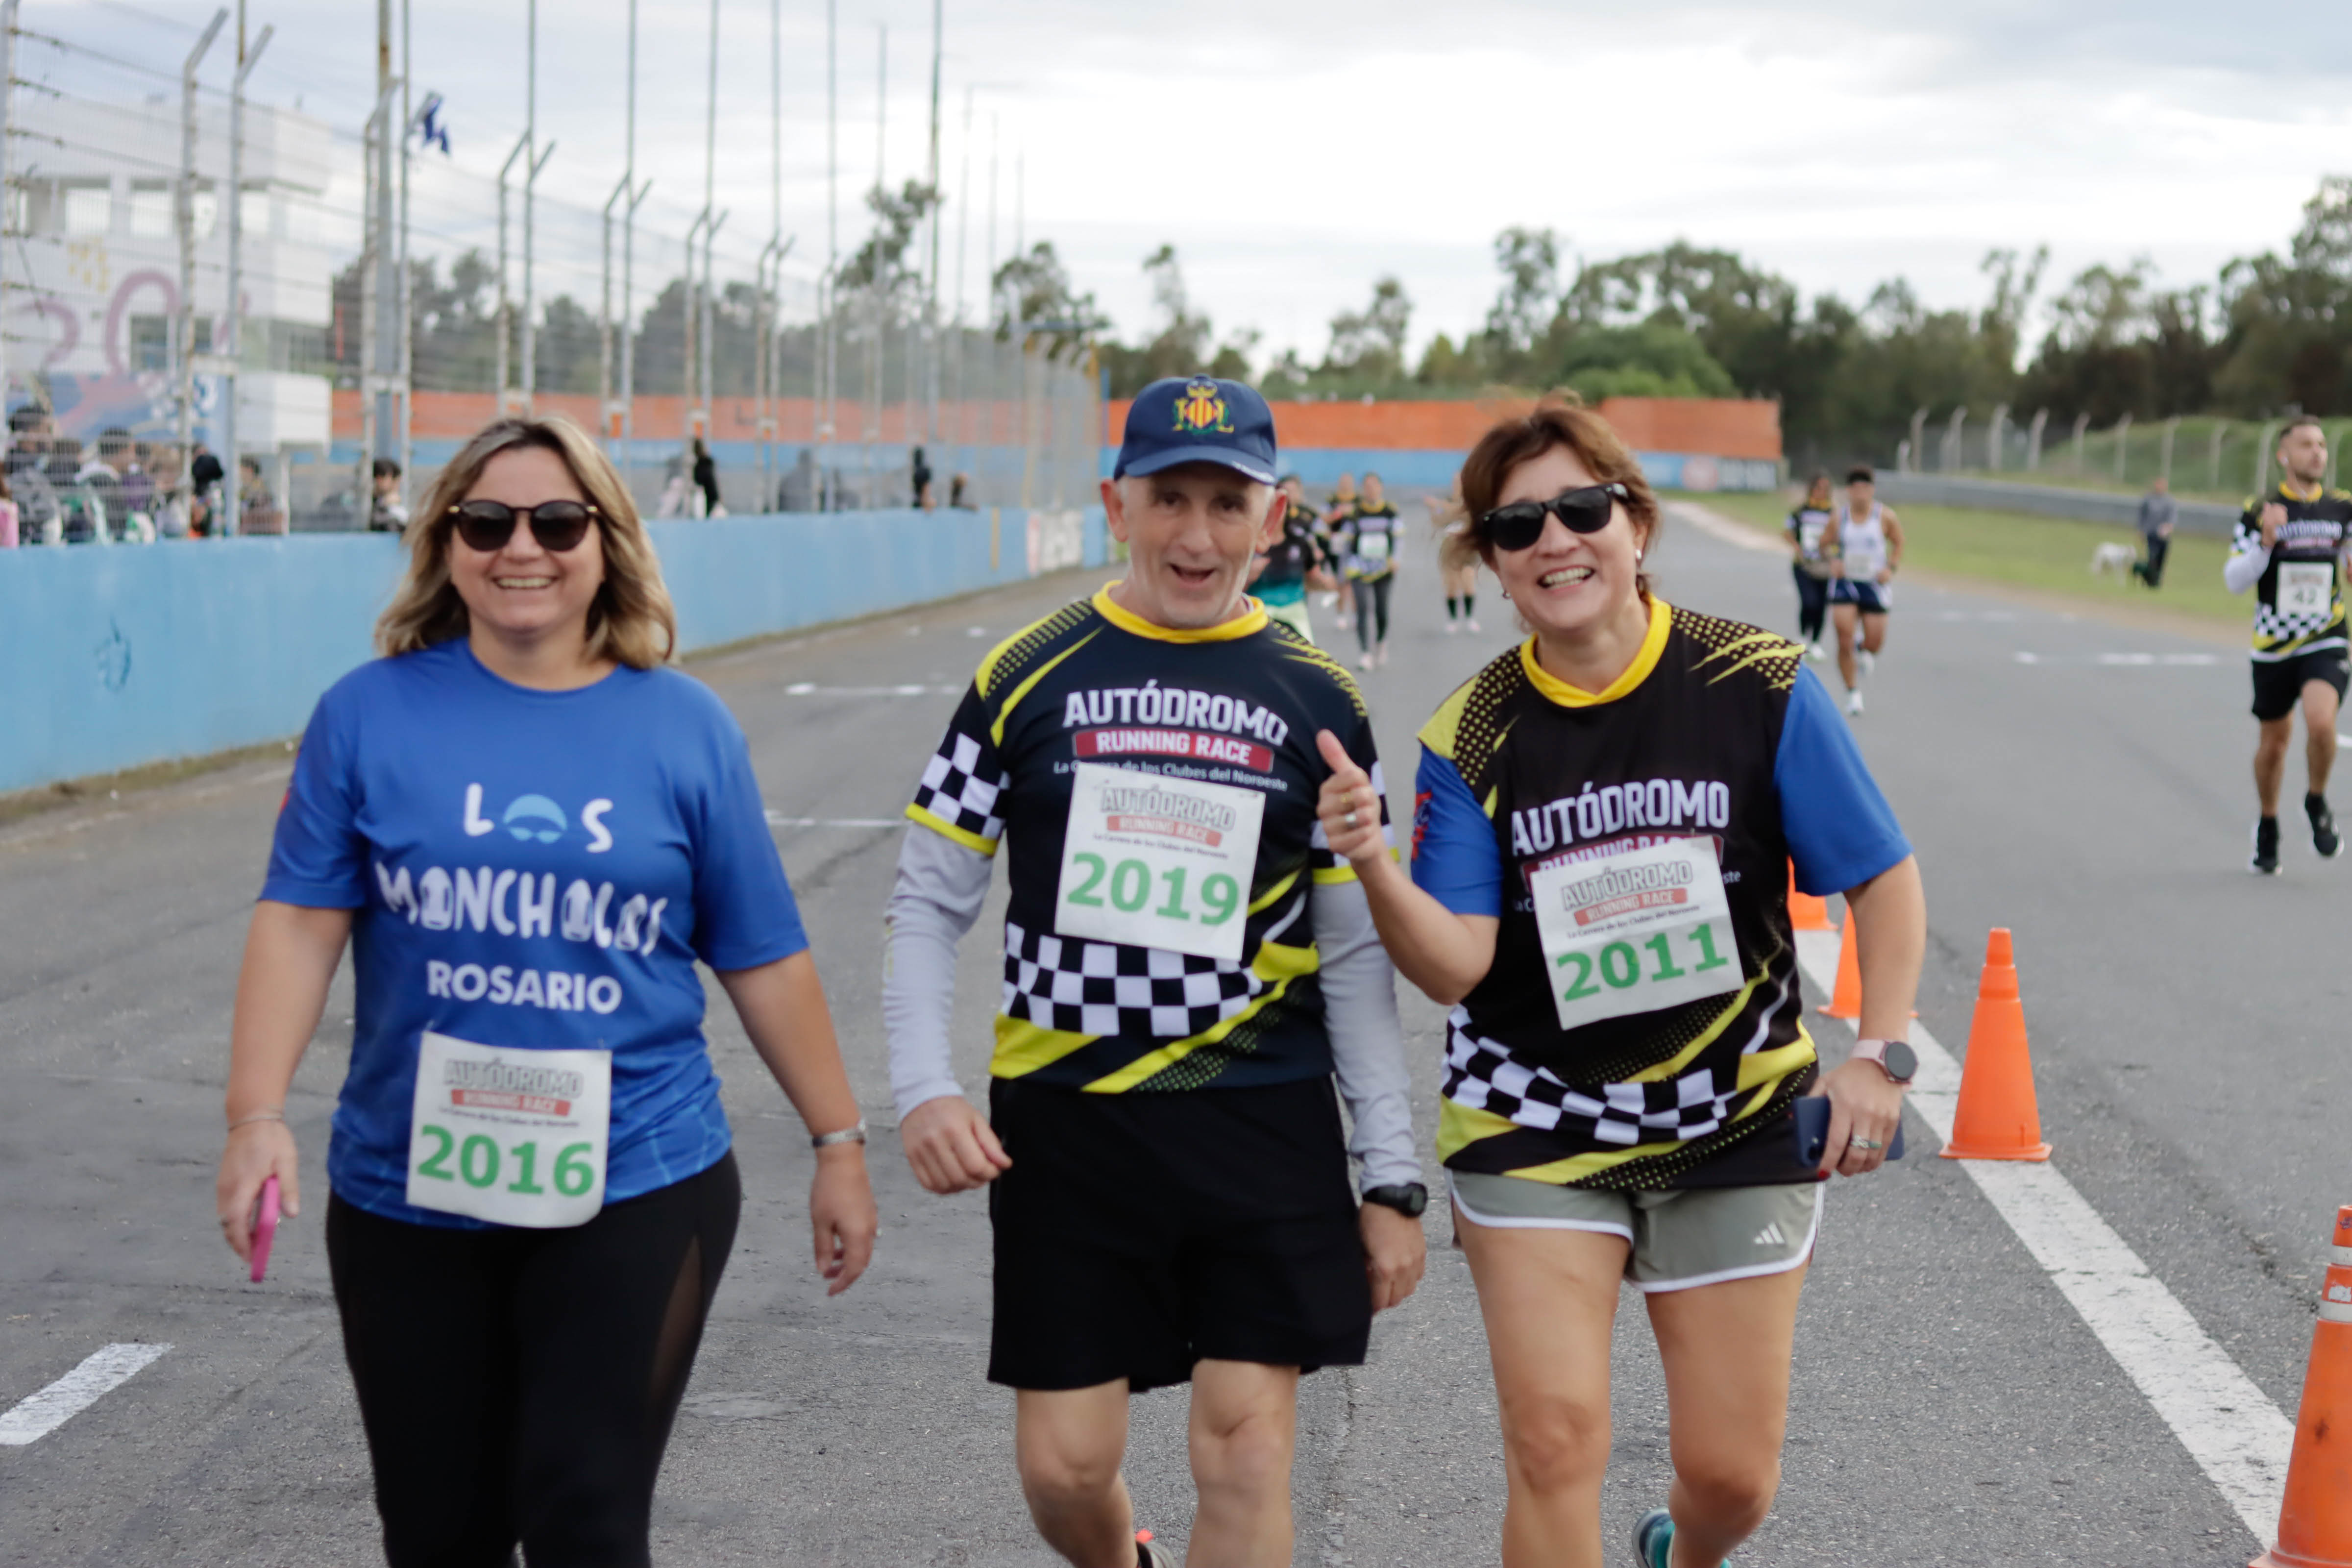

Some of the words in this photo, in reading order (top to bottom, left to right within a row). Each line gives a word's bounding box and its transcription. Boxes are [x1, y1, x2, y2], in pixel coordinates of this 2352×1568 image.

[1062, 679, 1288, 746] AUTÓDROMO
[1096, 731, 1190, 754] RUNNING
[1195, 735, 1252, 765] RACE
[1054, 760, 1069, 774] La
[1141, 761, 1160, 775] los
[1162, 762, 1207, 779] Clubes
[1208, 767, 1230, 782] del
[1232, 769, 1288, 792] Noroeste
[1101, 784, 1236, 832] AUTÓDROMO
[1511, 778, 1730, 857] AUTÓDROMO
[1067, 852, 1239, 927] 2019
[1562, 860, 1693, 911] AUTÓDROMO
[1585, 894, 1640, 921] RUNNING
[1642, 890, 1675, 906] RACE
[427, 960, 622, 1014] ROSARIO
[1556, 923, 1729, 1002] 2011
[417, 1124, 595, 1198] 2016
